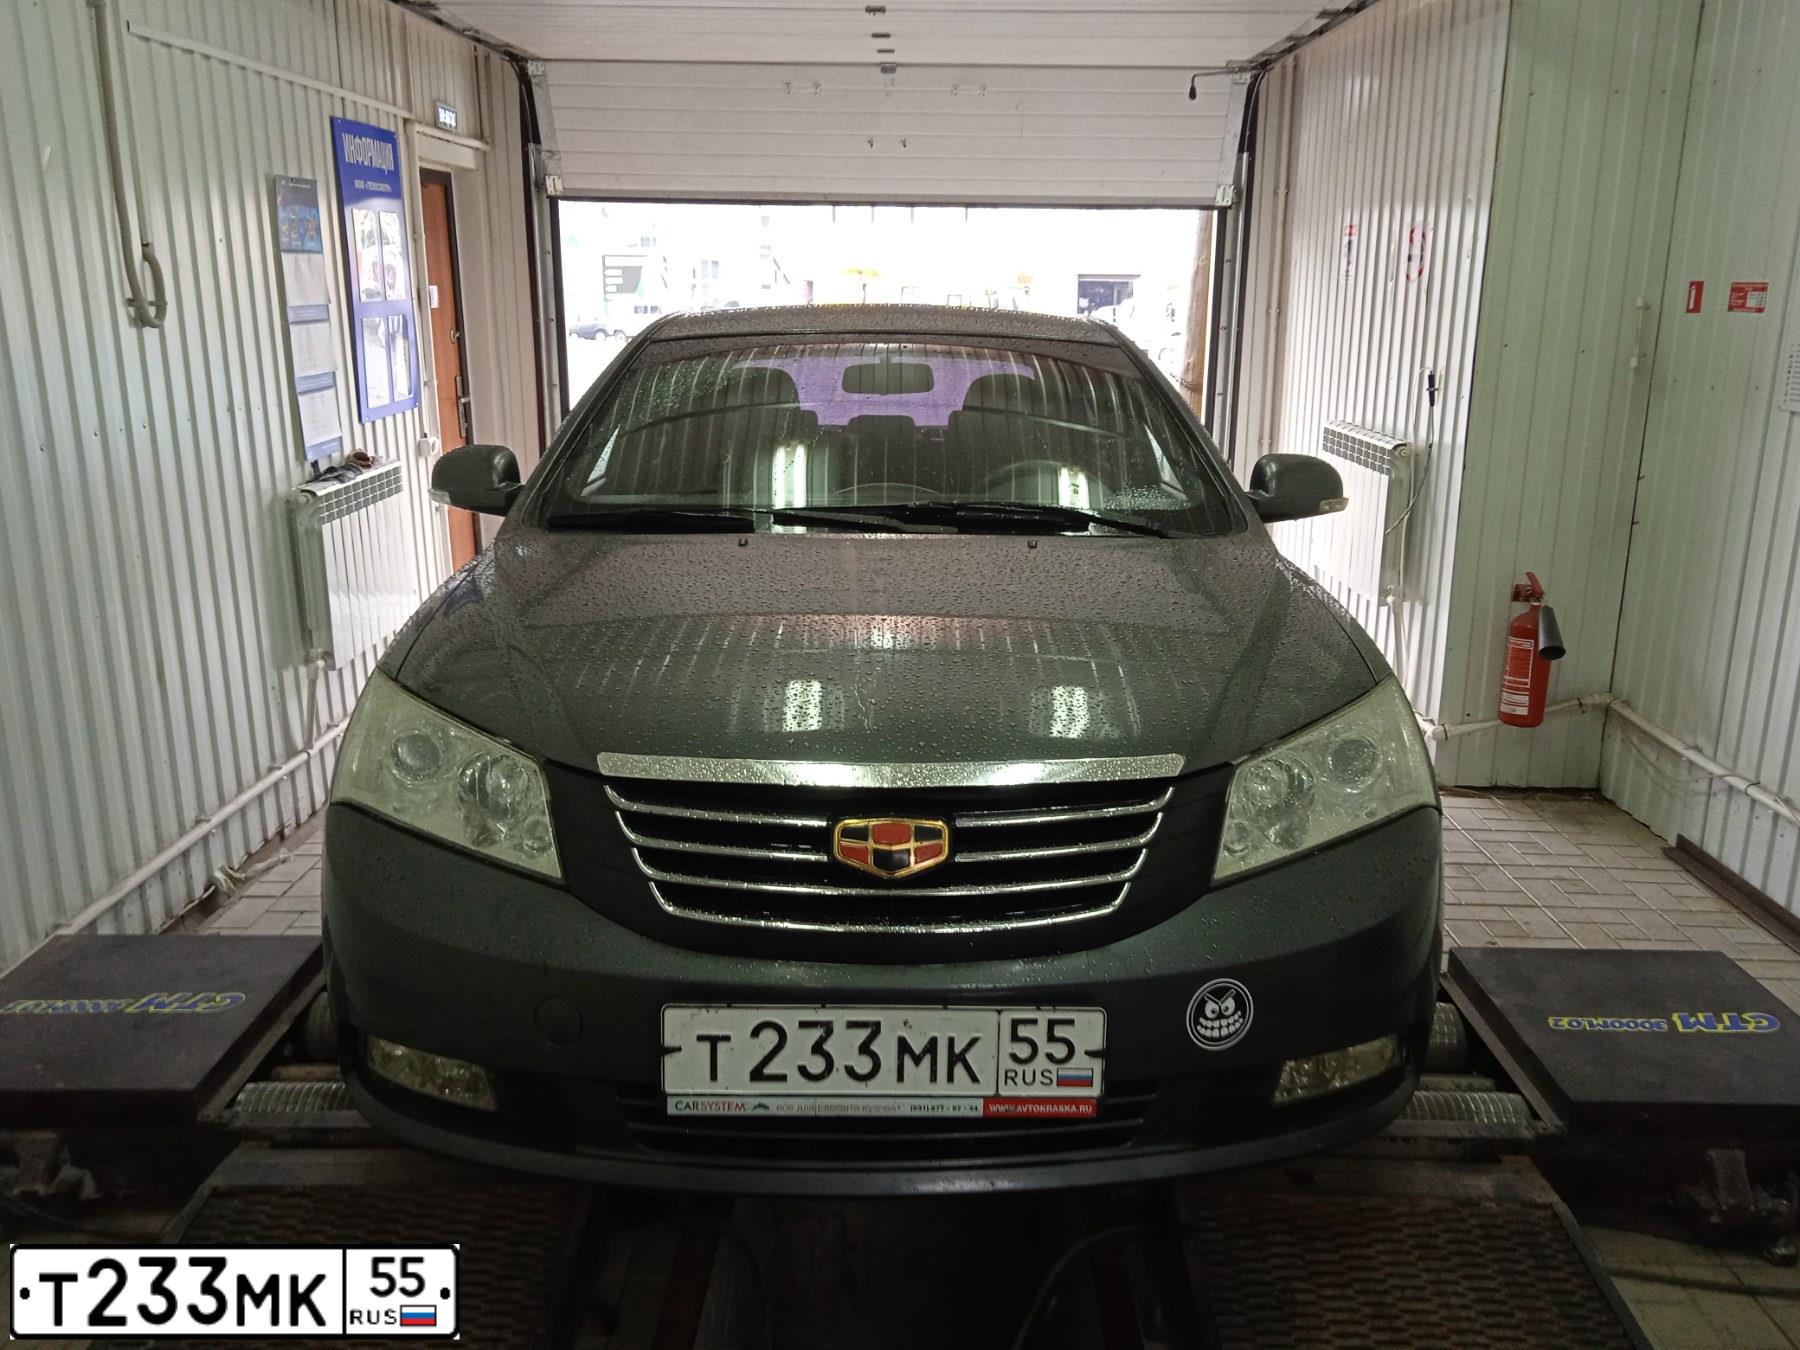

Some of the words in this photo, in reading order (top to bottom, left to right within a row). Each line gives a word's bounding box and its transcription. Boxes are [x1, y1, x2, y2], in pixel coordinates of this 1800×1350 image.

[342, 132, 395, 175] ИНФОРМАЦИЯ
[1009, 1018, 1076, 1065] 55
[1003, 1068, 1054, 1087] RUS
